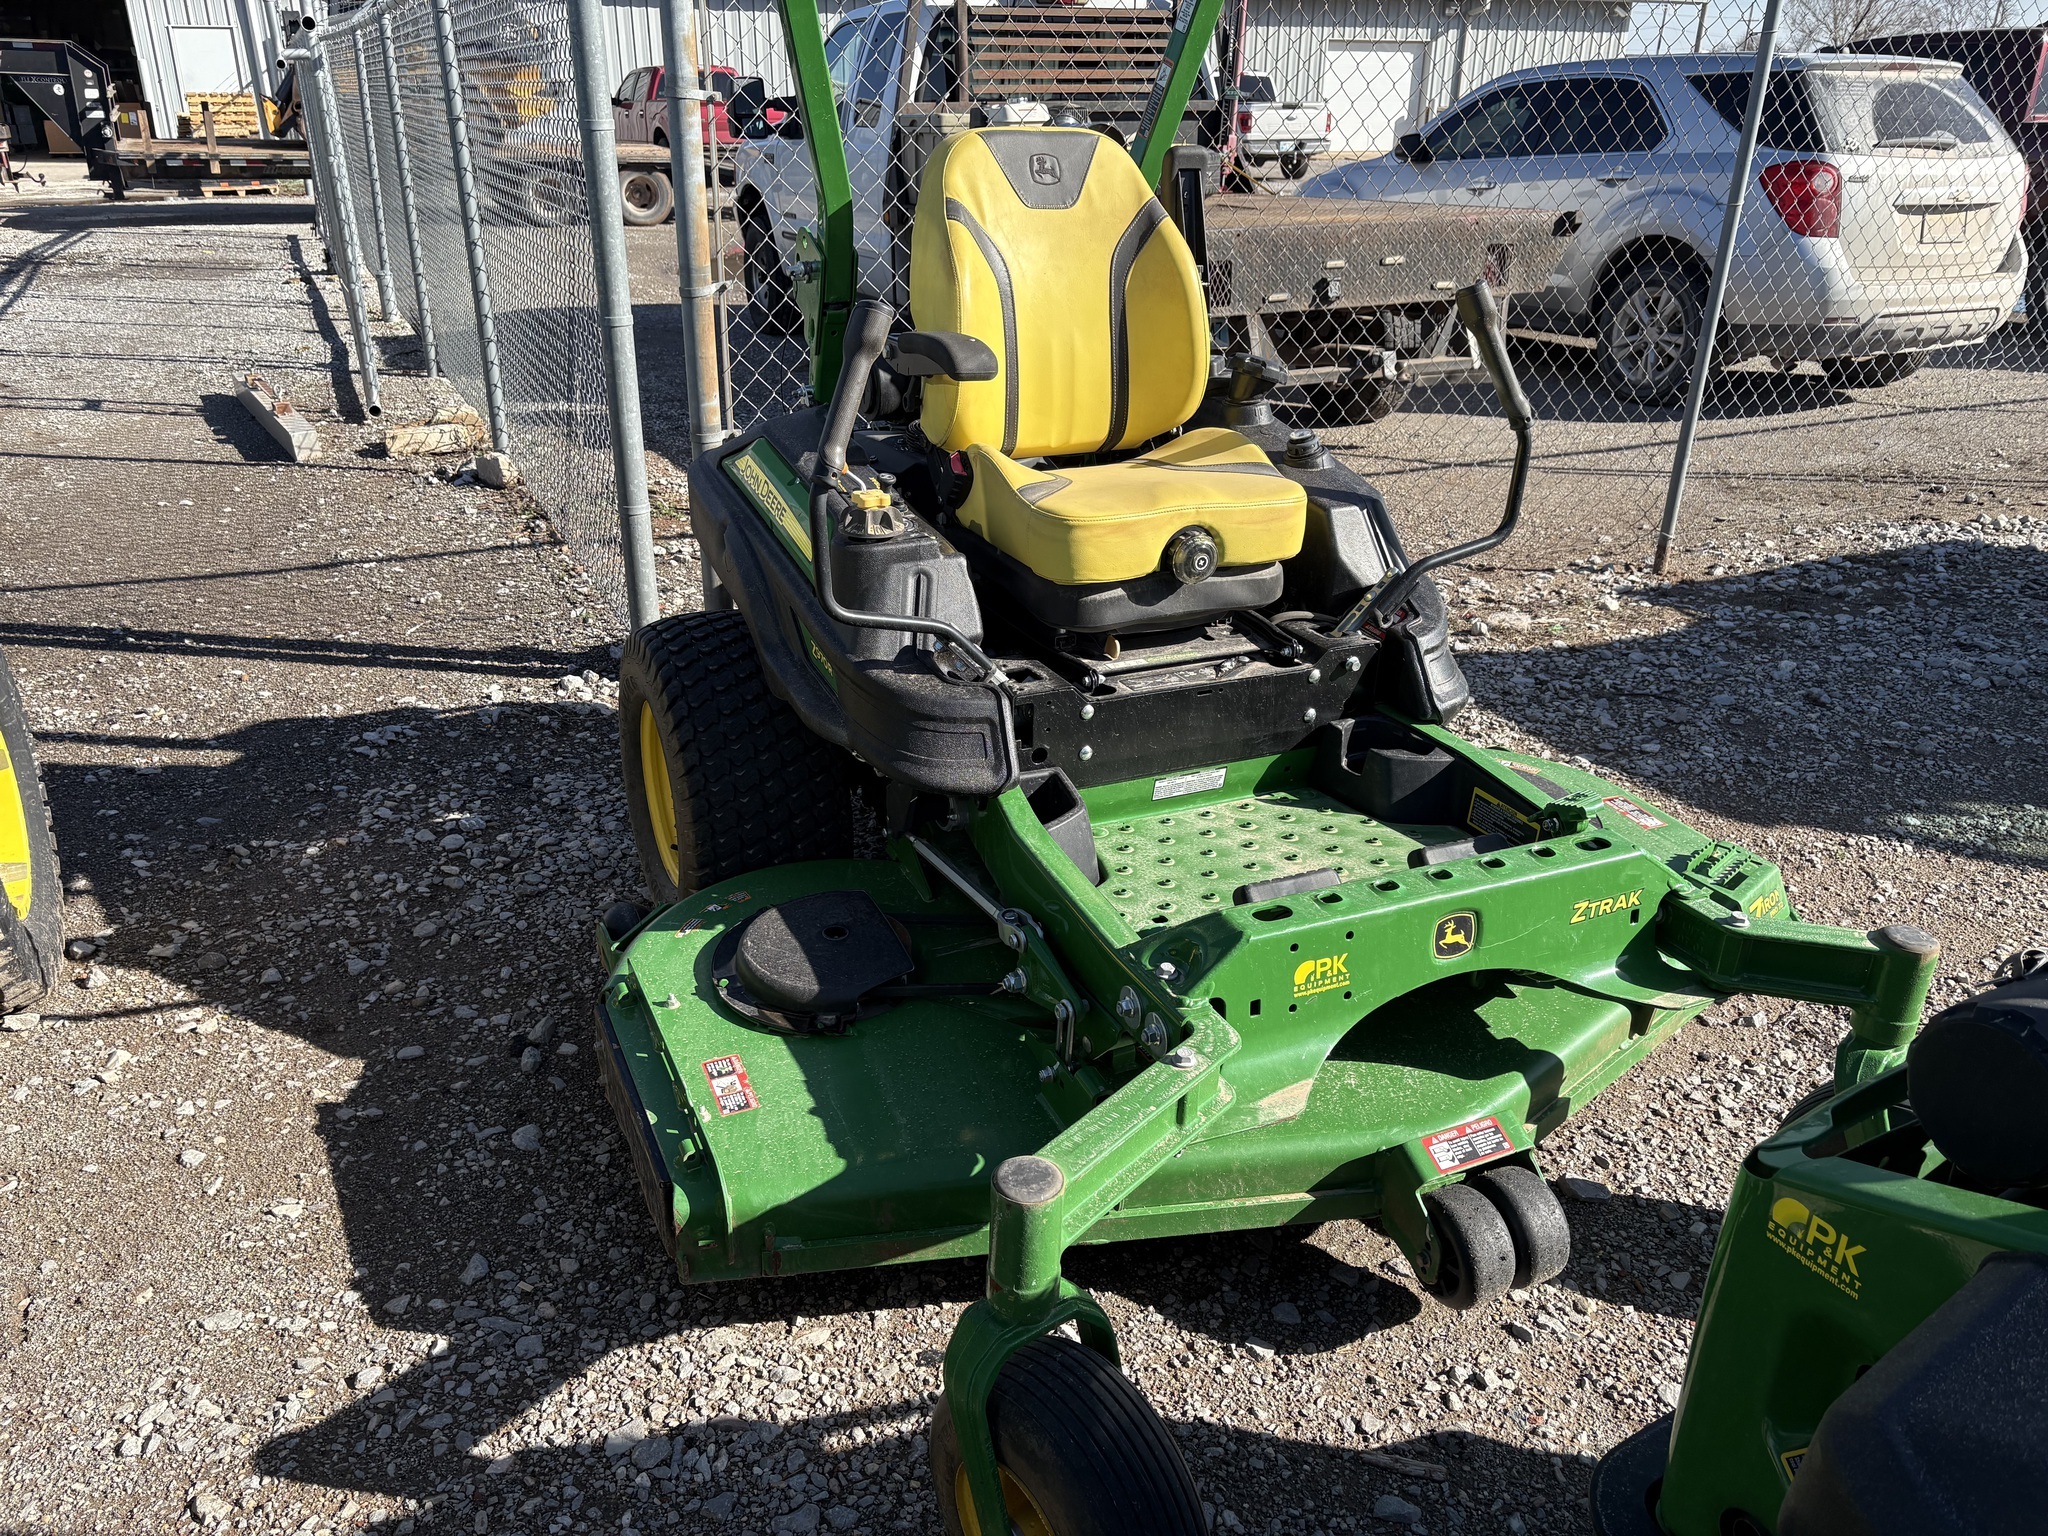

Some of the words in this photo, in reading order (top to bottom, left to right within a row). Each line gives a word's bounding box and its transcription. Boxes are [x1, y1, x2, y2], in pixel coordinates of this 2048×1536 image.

[740, 458, 763, 494] JOHN
[760, 479, 787, 524] DEERE
[1569, 888, 1644, 925] ZTRAK
[1293, 973, 1351, 993] EQUIPMENT
[1437, 1130, 1460, 1142] DANGER
[1470, 1119, 1493, 1131] PELIGRO
[1766, 1230, 1859, 1300] www.pkequipment.com
[1767, 1221, 1862, 1290] EQUIPMENT
